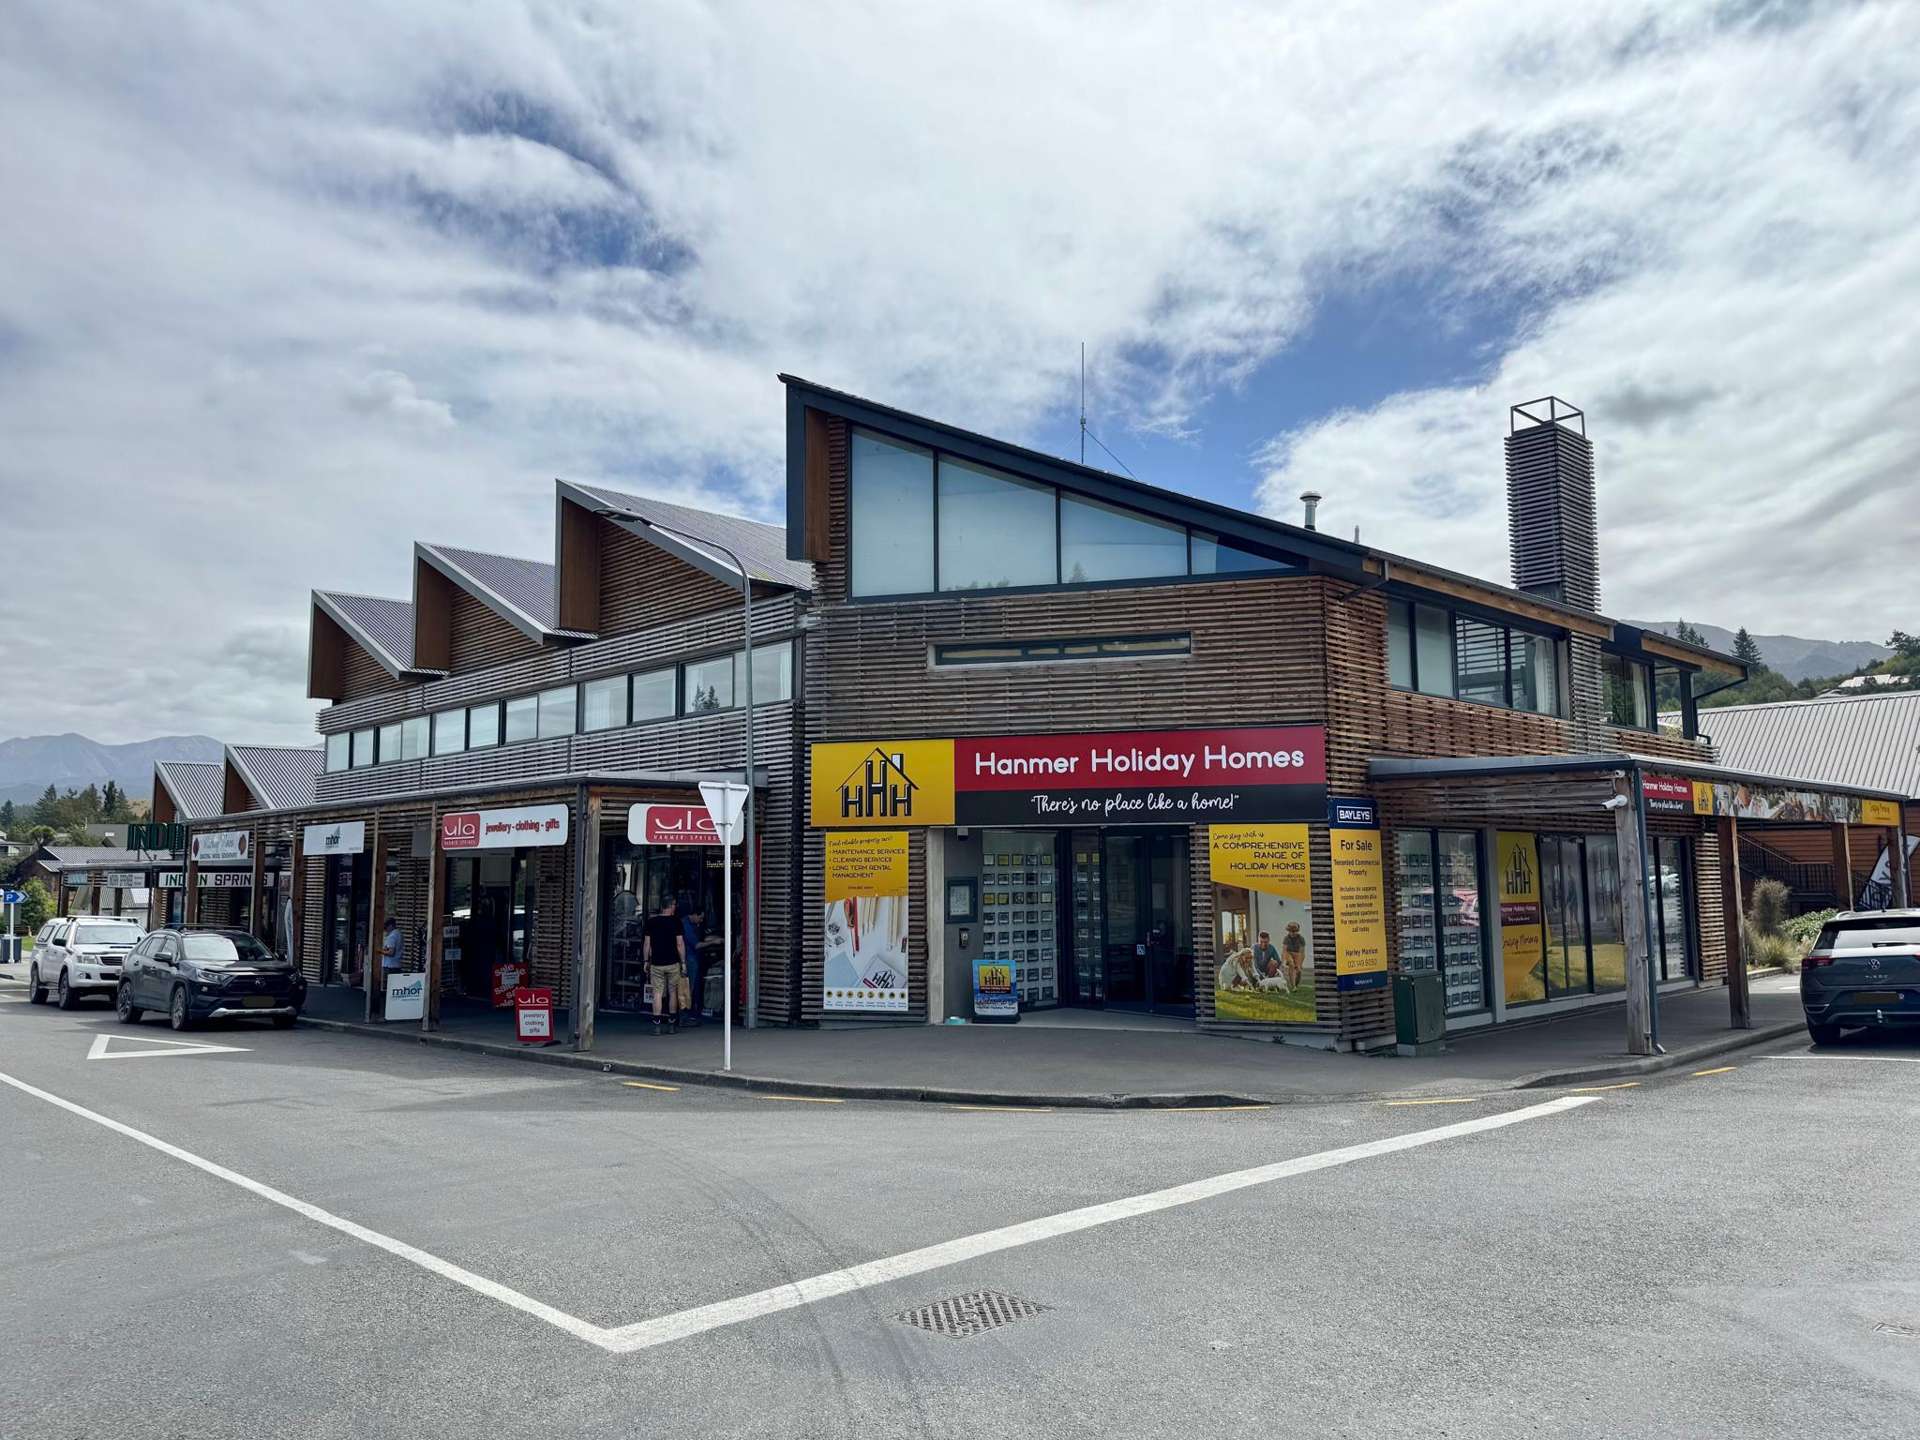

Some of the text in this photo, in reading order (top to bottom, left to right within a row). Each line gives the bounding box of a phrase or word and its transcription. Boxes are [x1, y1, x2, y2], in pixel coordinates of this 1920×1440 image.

[976, 745, 1304, 778] Hanmer Holiday Homes
[842, 760, 911, 817] HHH
[1081, 801, 1101, 812] no
[1105, 793, 1144, 817] place
[1147, 793, 1174, 810] like
[1177, 800, 1188, 810] a
[1340, 810, 1370, 820] BAYLEYS
[445, 817, 475, 836] ula
[515, 820, 539, 832] clothing
[545, 818, 559, 831] gifts
[1222, 841, 1304, 850] COMPREHENSIVE
[1341, 840, 1373, 851] For Sale
[1254, 851, 1304, 859] RANGE OF
[1230, 862, 1305, 870] HOLIDAY HOMES
[166, 874, 268, 886] INDN SPRINS
[6, 894, 13, 902] P
[392, 986, 422, 996] mhor
[519, 994, 549, 1004] ula
